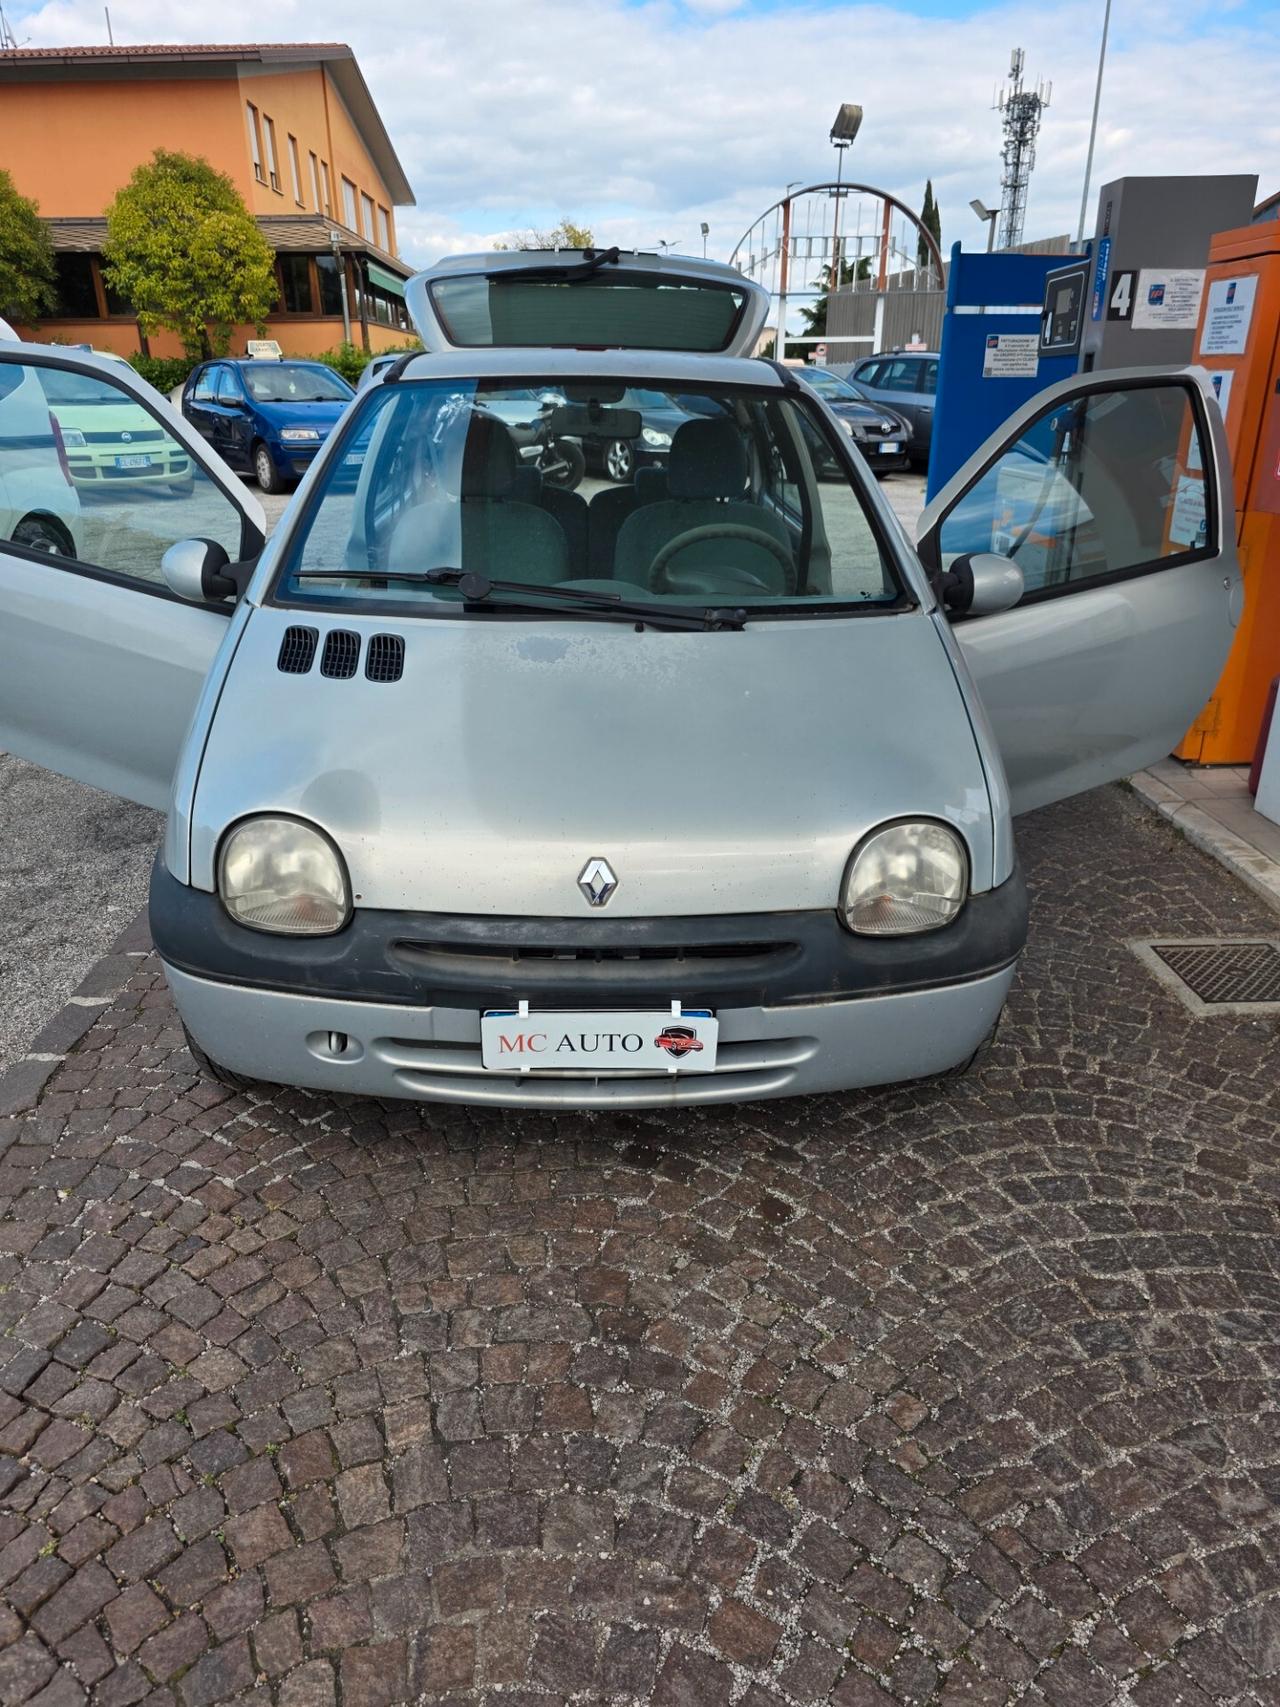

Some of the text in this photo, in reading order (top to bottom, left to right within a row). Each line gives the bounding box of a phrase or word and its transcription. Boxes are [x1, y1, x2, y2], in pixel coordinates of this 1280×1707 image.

[1110, 273, 1132, 317] 4
[498, 1033, 644, 1053] MC AUTO
